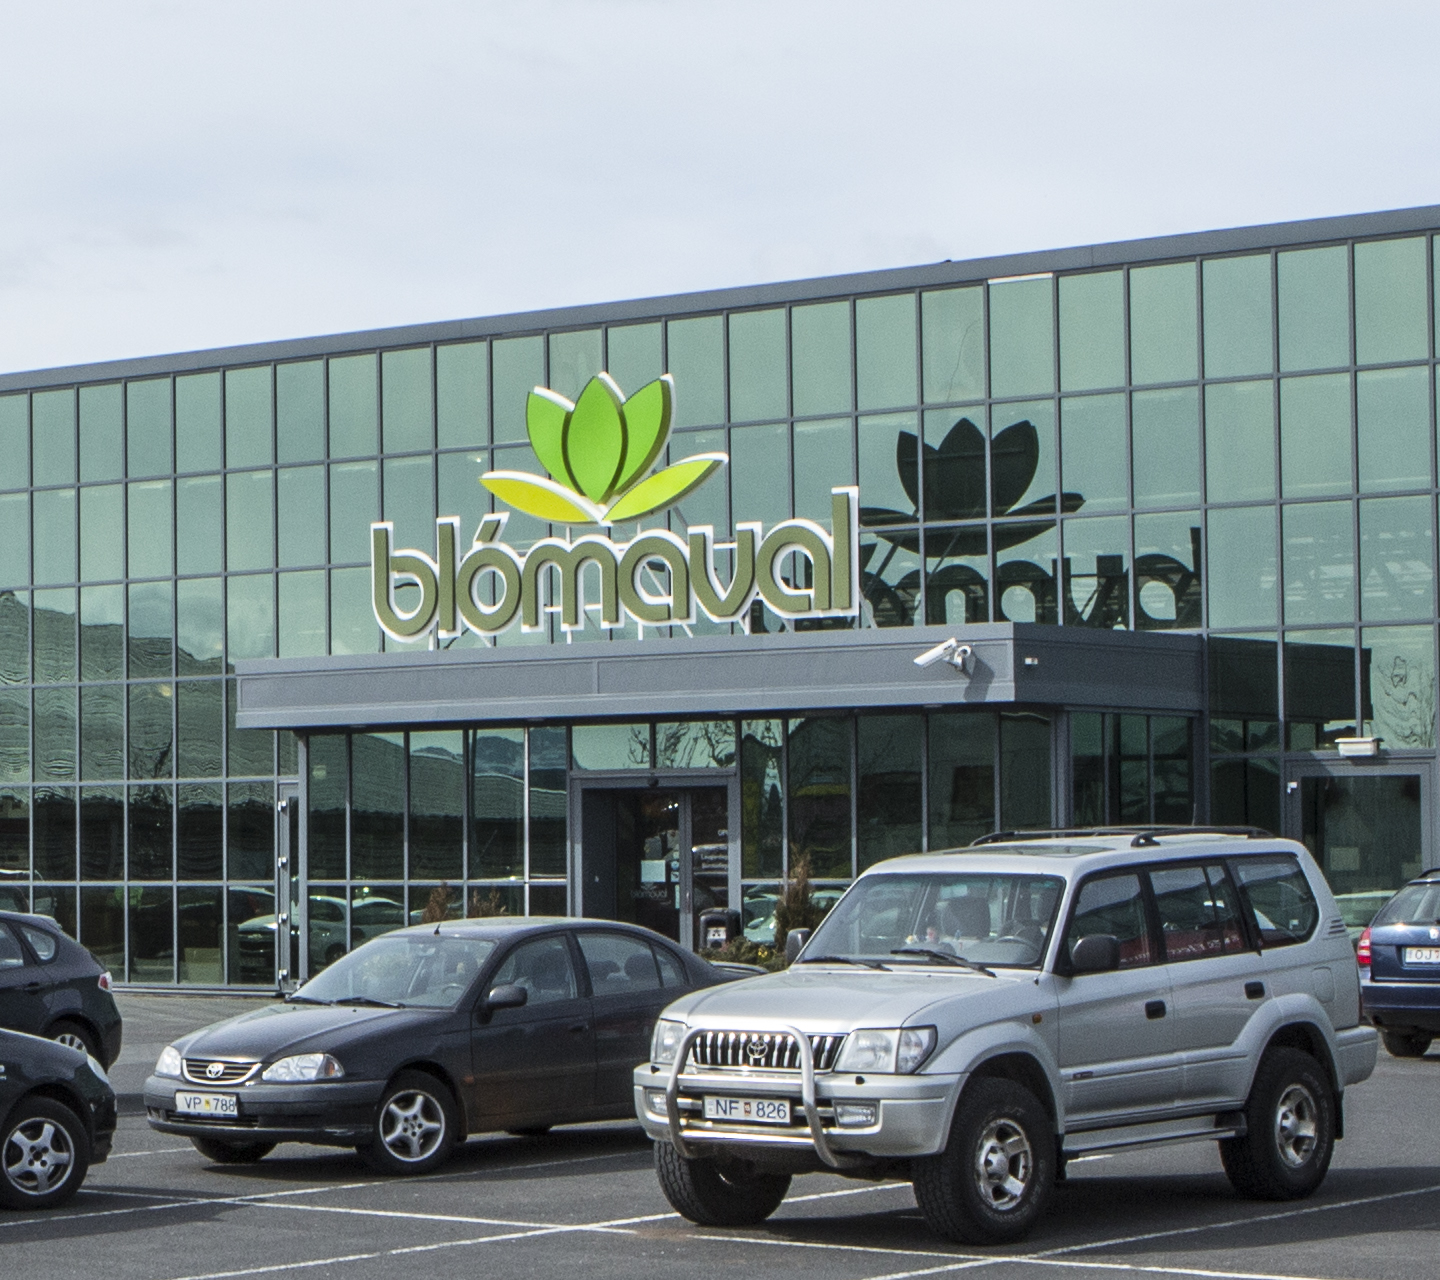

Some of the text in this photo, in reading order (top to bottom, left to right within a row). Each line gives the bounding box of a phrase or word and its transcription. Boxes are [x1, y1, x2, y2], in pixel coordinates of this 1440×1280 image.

[371, 486, 860, 643] blómaval
[184, 1096, 236, 1113] VP 788
[715, 1099, 788, 1120] NF 826
